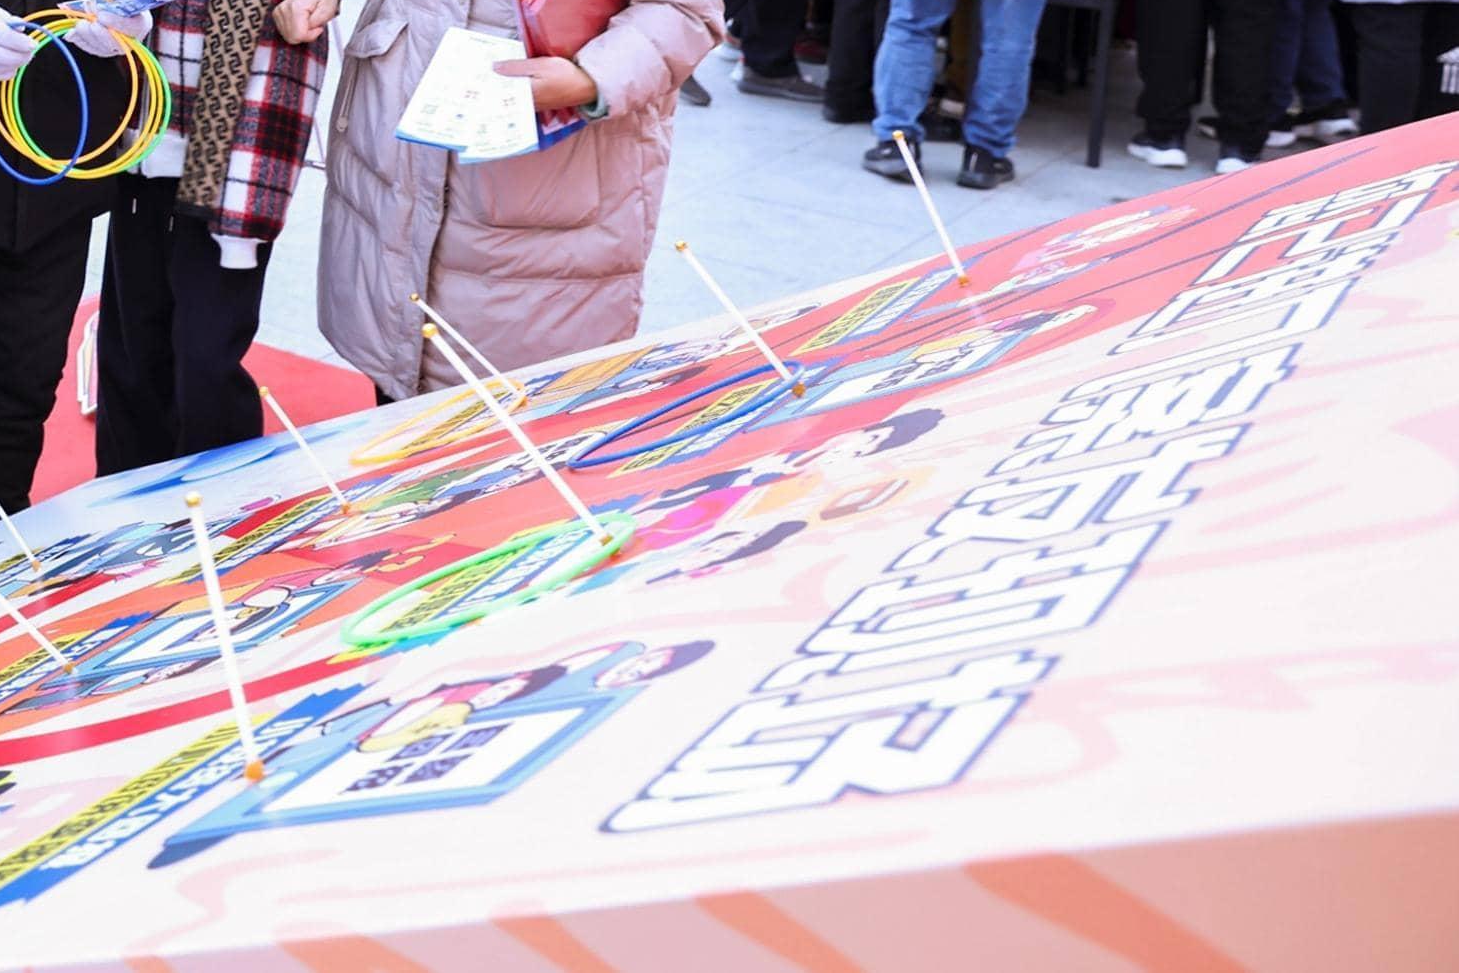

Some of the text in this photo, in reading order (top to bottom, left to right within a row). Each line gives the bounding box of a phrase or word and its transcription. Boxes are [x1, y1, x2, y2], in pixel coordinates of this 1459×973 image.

[598, 160, 1459, 833] 您已进入案发现场
